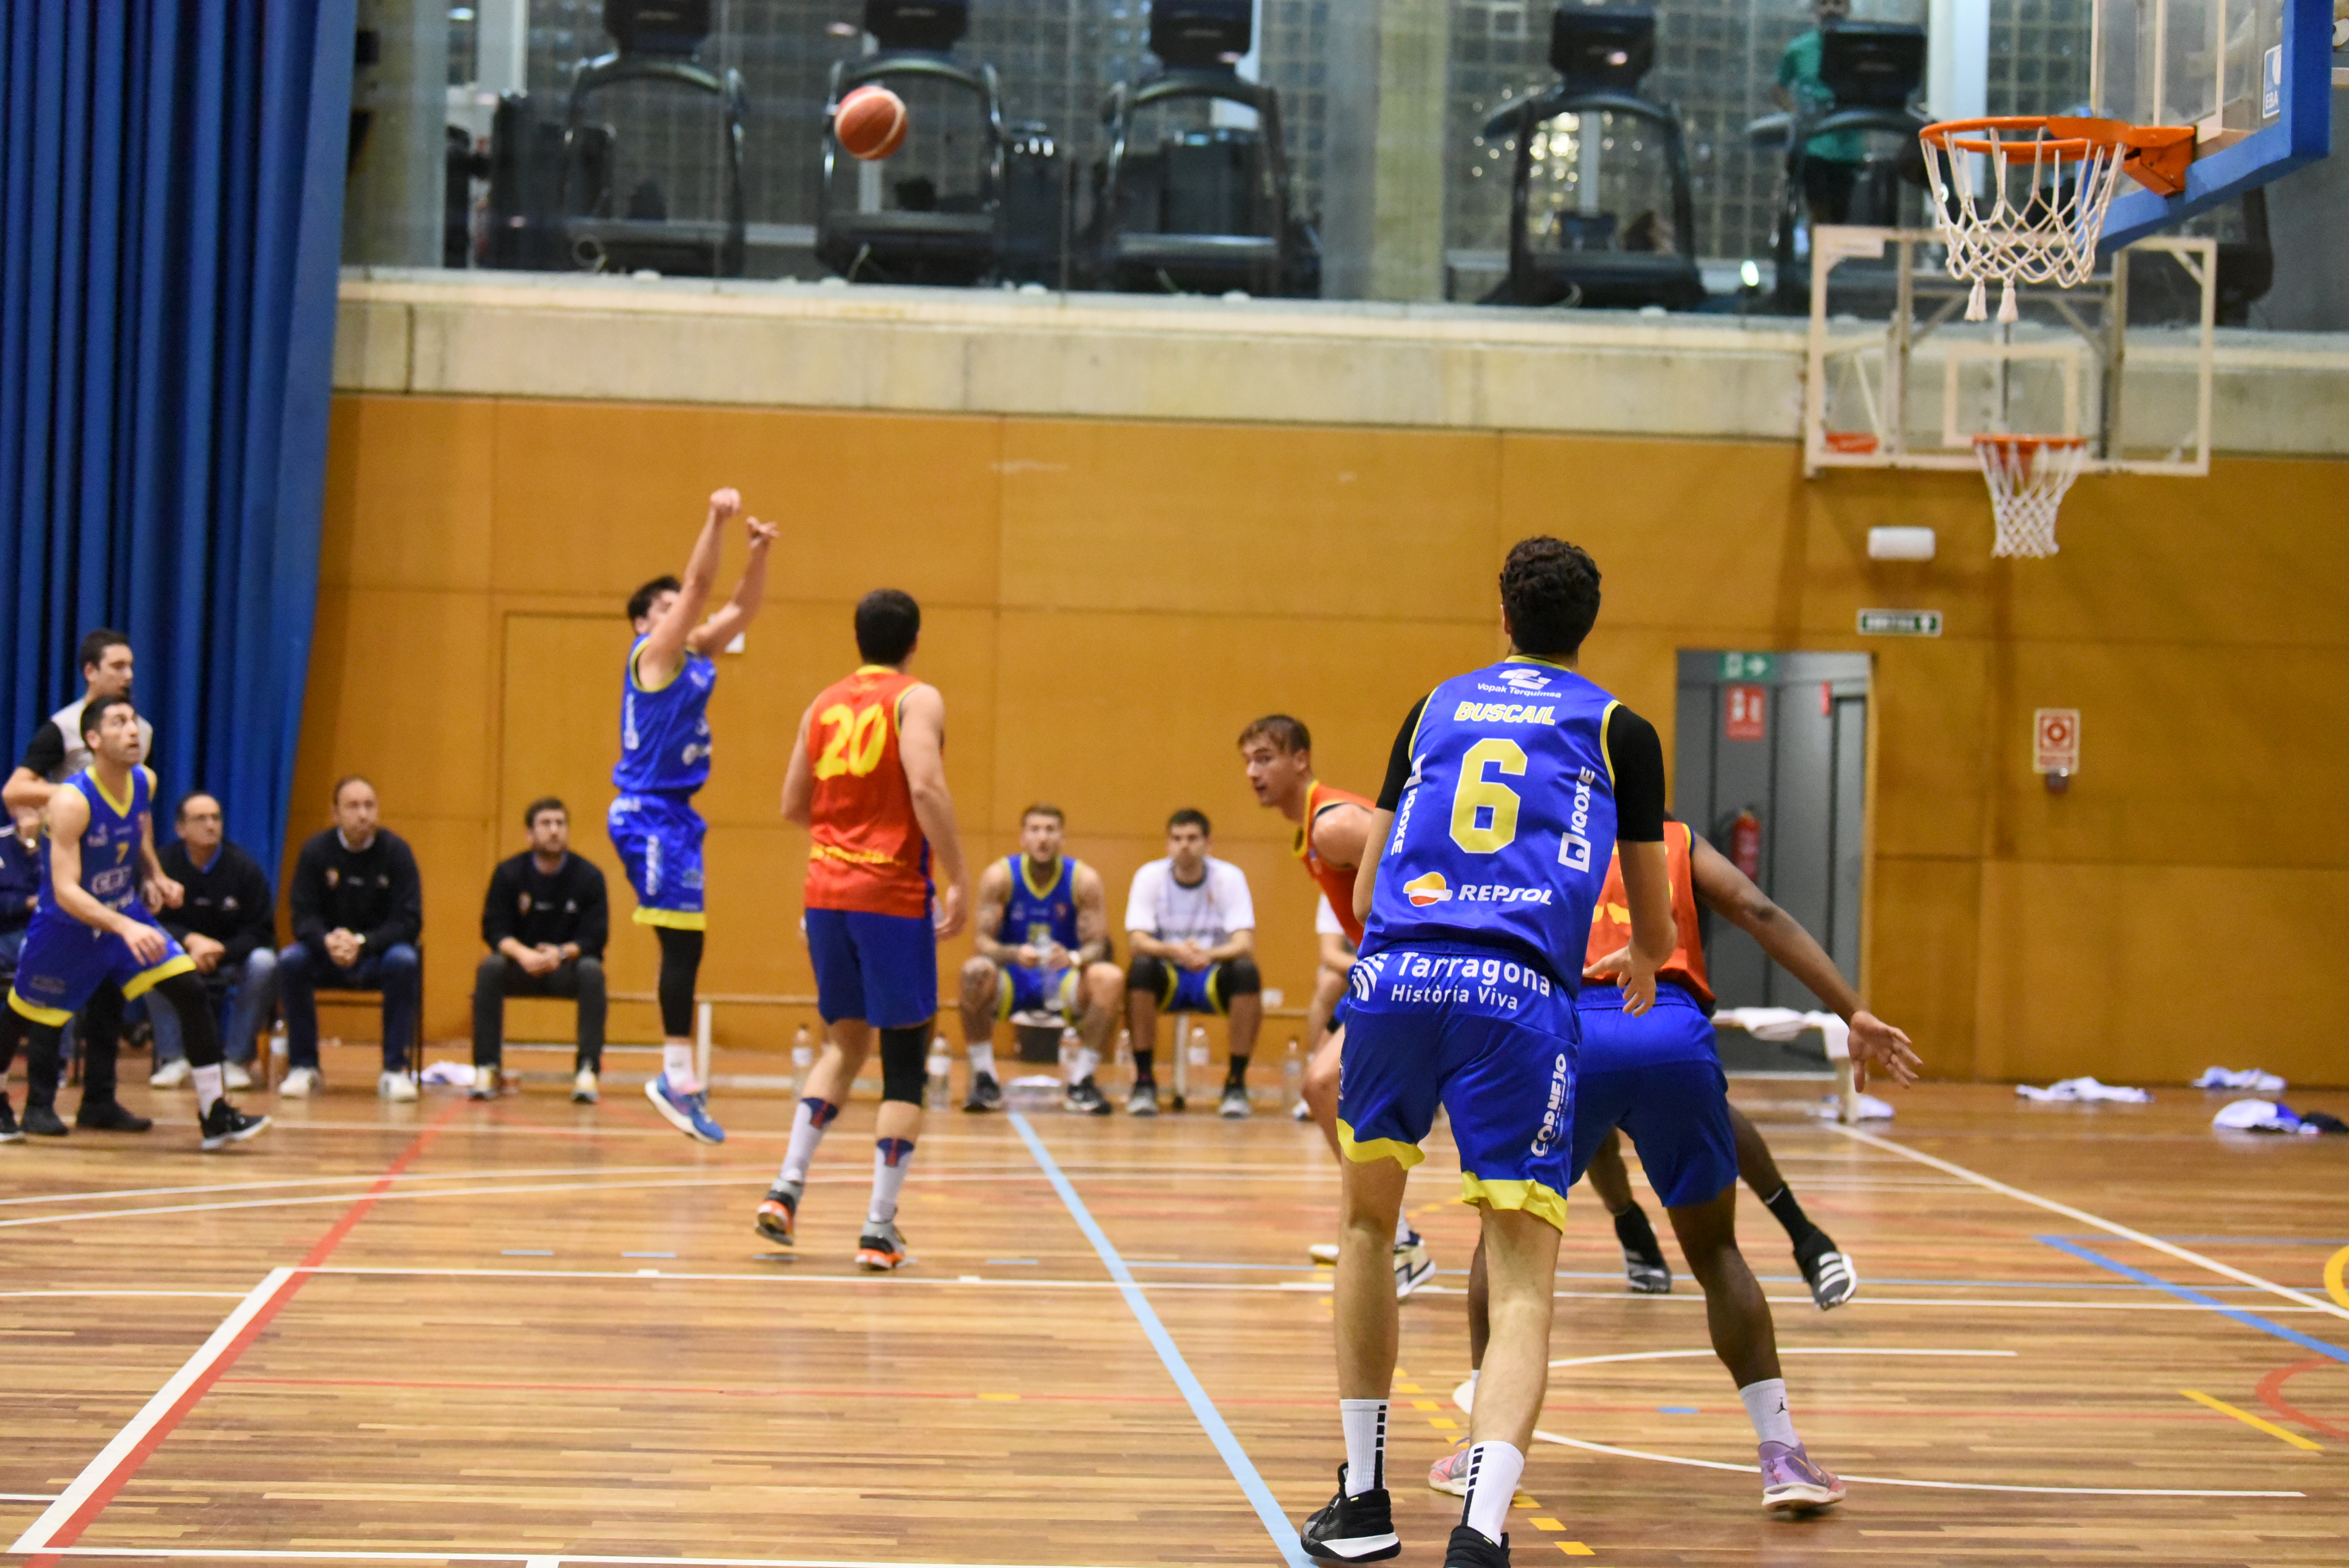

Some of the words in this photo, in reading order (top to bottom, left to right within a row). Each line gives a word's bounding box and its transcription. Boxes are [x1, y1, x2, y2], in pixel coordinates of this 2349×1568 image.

[2265, 90, 2279, 110] EBA
[1478, 682, 1507, 693] Vopak
[1510, 686, 1562, 698] Terquimsa
[1454, 701, 1556, 726] BUSCAIL
[814, 704, 888, 780] 20
[1449, 738, 1529, 854] 6
[1571, 766, 1595, 836] IQOXE
[1390, 788, 1418, 856] IQOXE
[1458, 884, 1552, 905] REPSOL
[1398, 951, 1550, 998] Tarragona
[1391, 984, 1470, 1003] Història
[1477, 985, 1518, 1010] Viva
